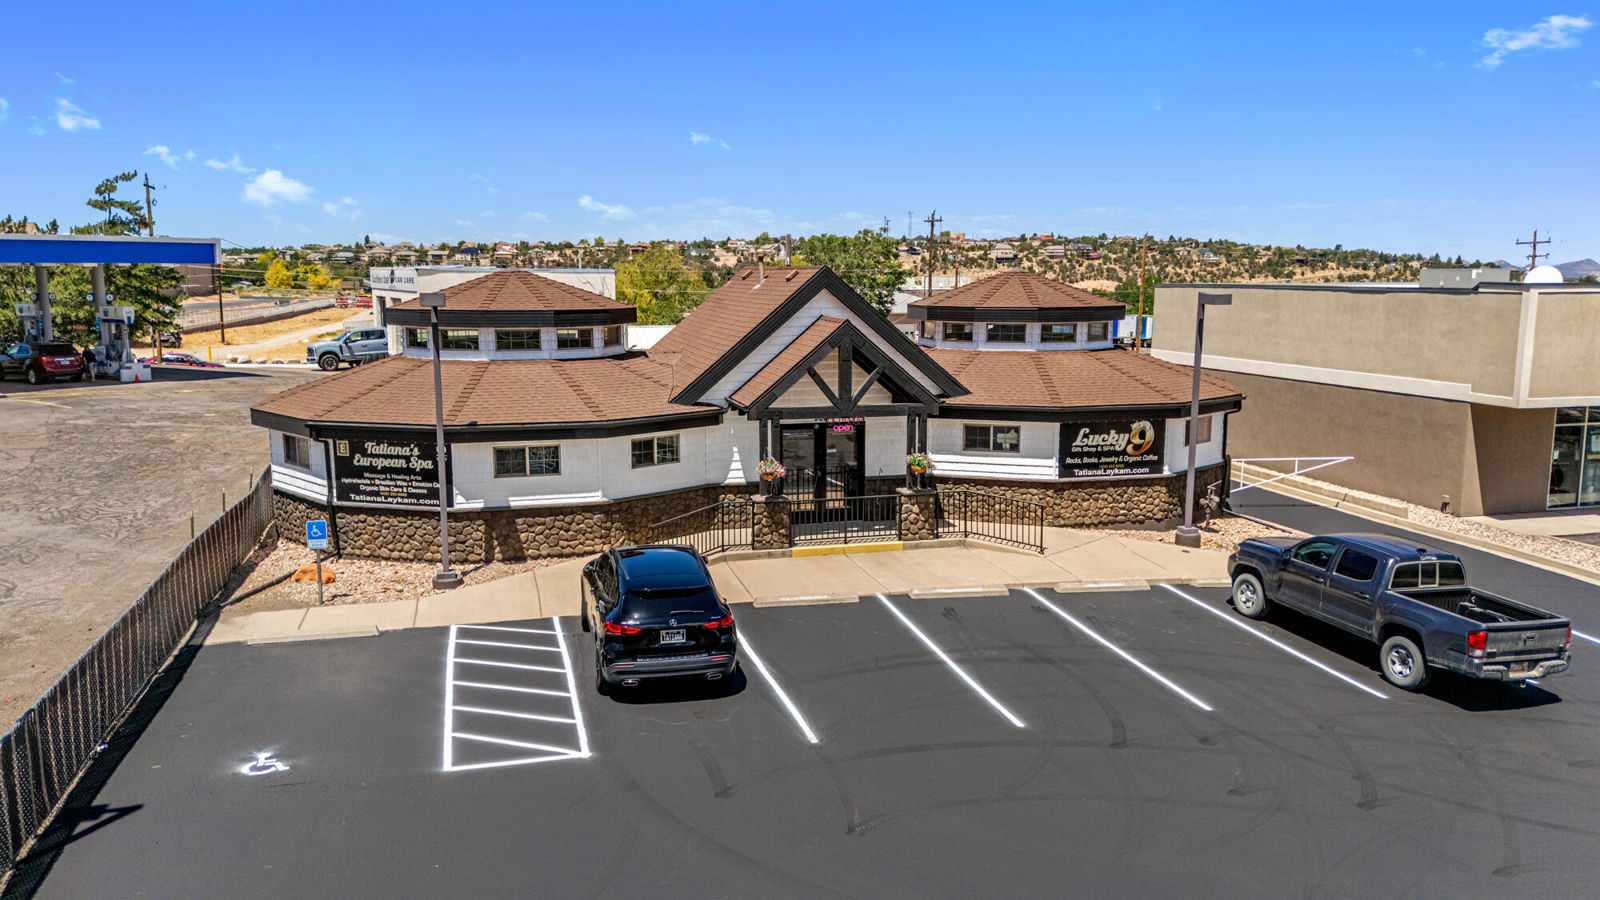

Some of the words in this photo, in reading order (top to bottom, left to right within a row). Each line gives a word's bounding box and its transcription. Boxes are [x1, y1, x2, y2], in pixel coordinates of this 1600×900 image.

[1072, 428, 1129, 451] Lucky
[1126, 420, 1154, 455] 9
[365, 442, 420, 456] Tatiana's
[353, 454, 407, 470] European
[409, 456, 434, 472] Spa
[1099, 456, 1118, 464] Jewelry
[1124, 455, 1142, 463] Organic
[1074, 467, 1149, 476] TatianaLaykam.com
[349, 493, 440, 505] TatianaLaykam.com
